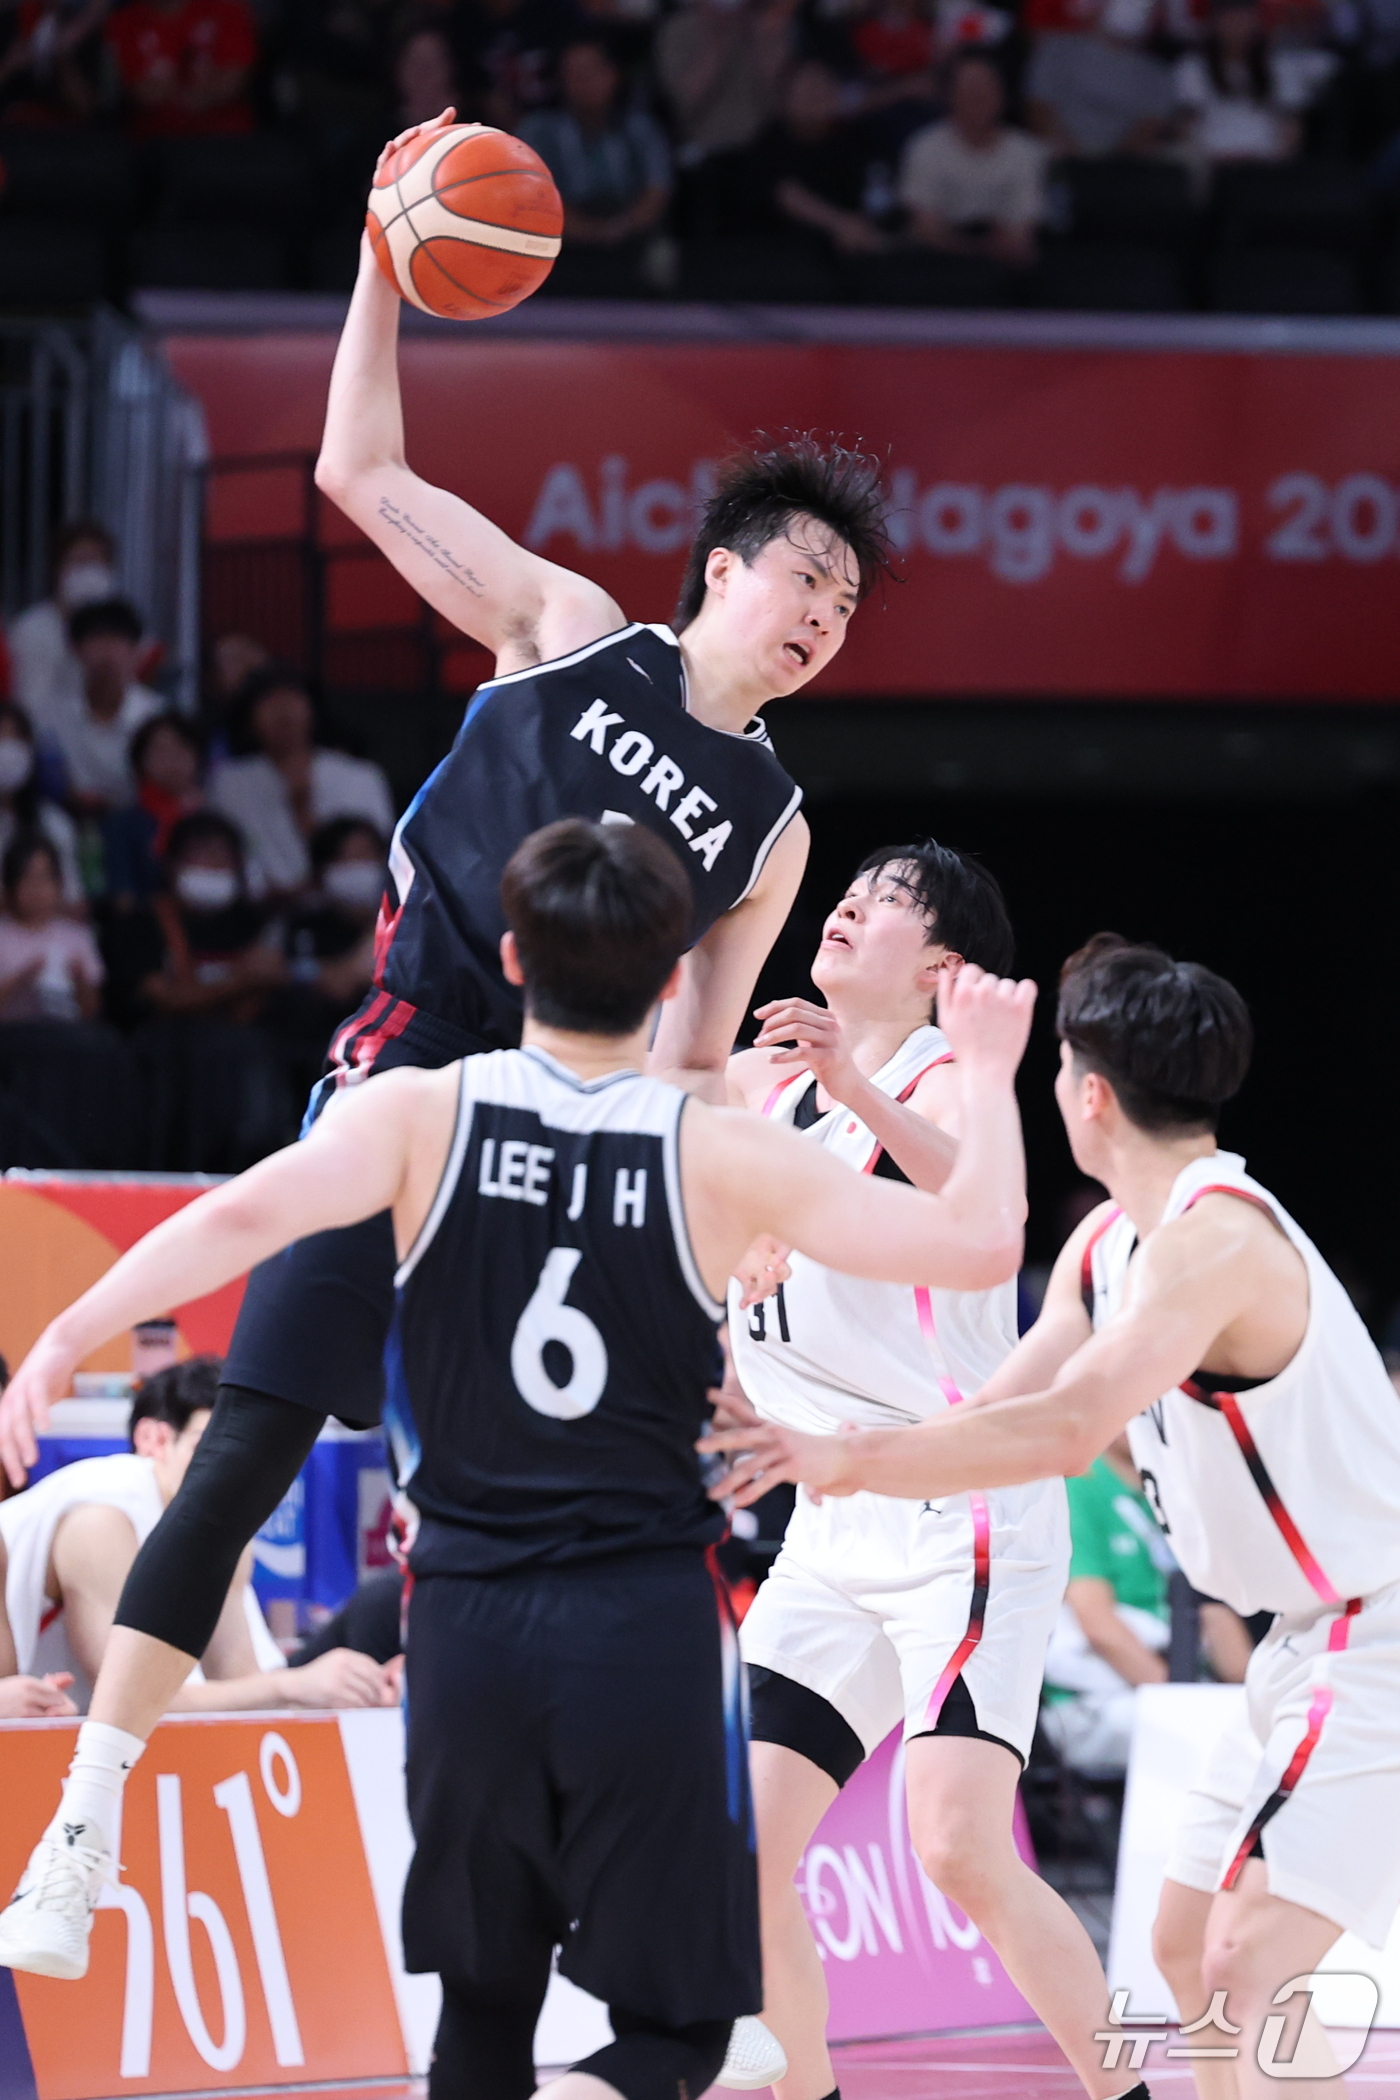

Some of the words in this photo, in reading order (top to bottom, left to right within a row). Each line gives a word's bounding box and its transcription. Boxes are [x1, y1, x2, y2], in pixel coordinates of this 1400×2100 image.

[523, 455, 719, 553] Aic
[1263, 471, 1400, 563] 20
[570, 698, 733, 872] KOREA
[478, 1137, 556, 1206] LEE
[566, 1162, 588, 1221] J
[612, 1167, 648, 1229] H
[510, 1246, 609, 1421] 6
